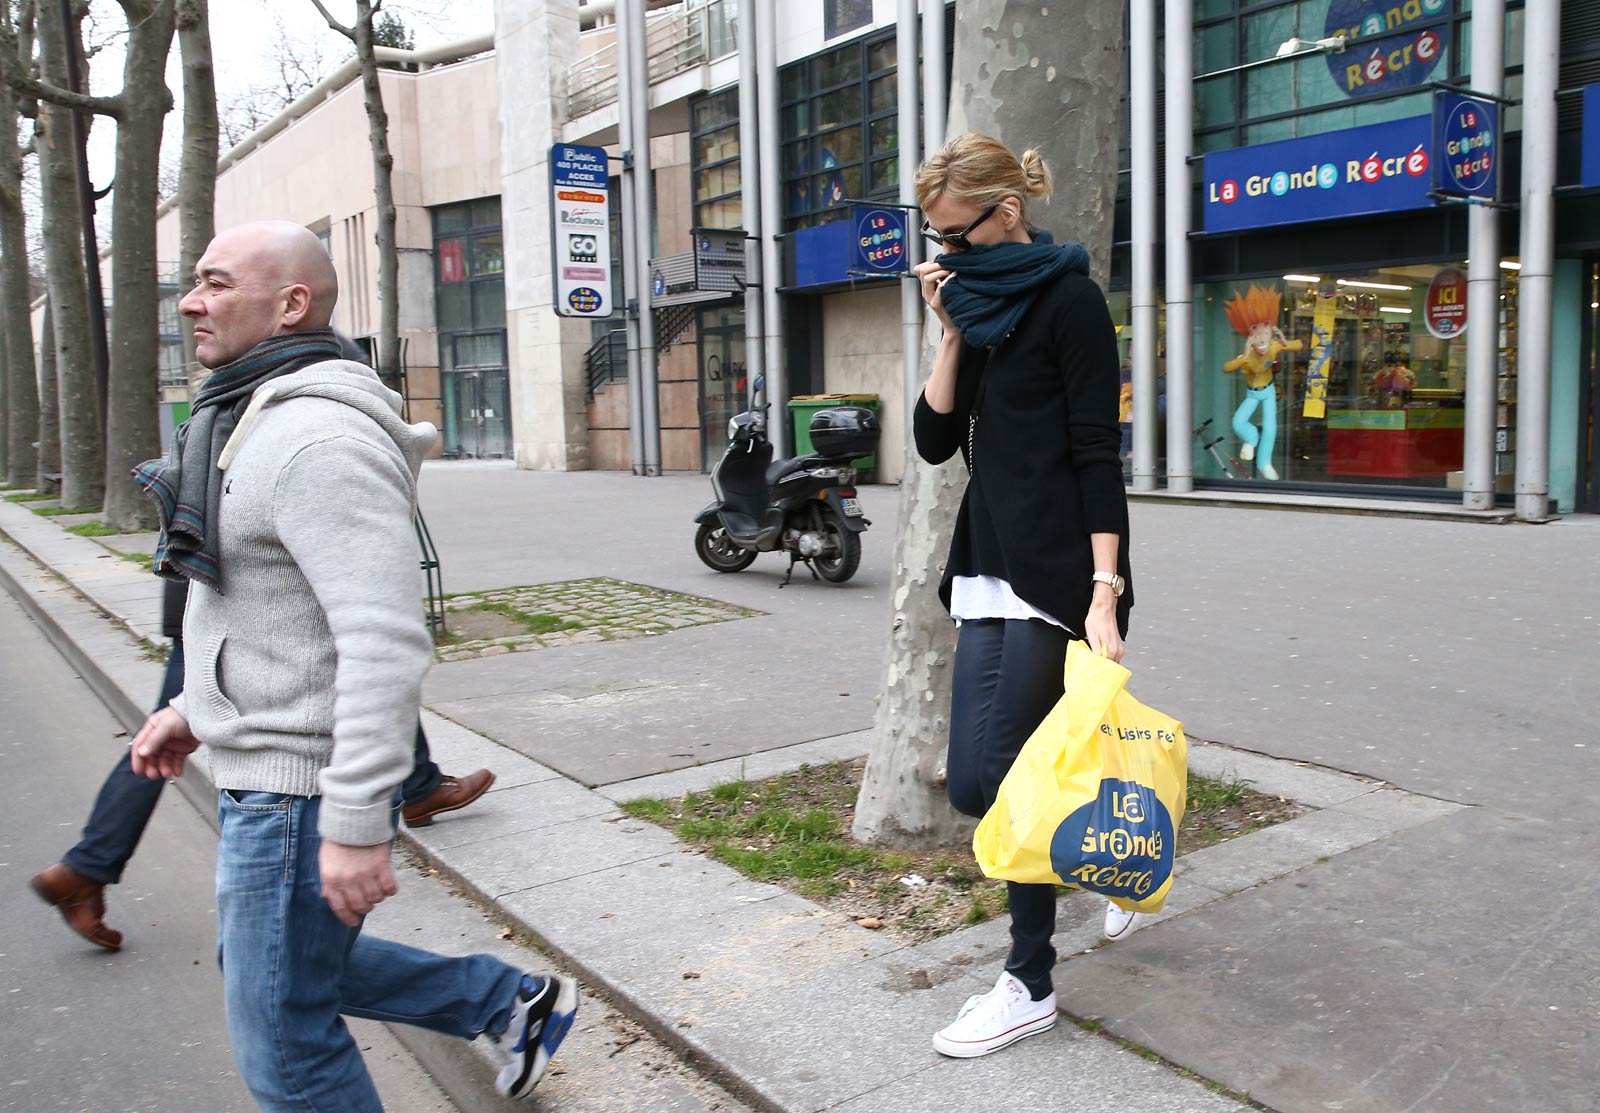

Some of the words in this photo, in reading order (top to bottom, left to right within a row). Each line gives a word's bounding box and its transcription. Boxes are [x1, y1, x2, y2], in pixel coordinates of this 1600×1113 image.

[1346, 31, 1434, 91] Récré
[1460, 114, 1475, 128] La
[1447, 130, 1490, 156] Grande
[564, 149, 596, 162] Public
[572, 163, 604, 171] PLACES
[1209, 183, 1234, 203] La
[1245, 165, 1333, 197] Grande
[1346, 144, 1424, 183] Récré
[1455, 152, 1489, 179] Récré
[568, 173, 594, 181] ACCES
[871, 218, 886, 229] La
[570, 237, 596, 255] GO
[860, 229, 901, 247] Grande
[868, 242, 901, 262] Récré
[1438, 287, 1457, 304] ICI
[1112, 791, 1145, 823] La
